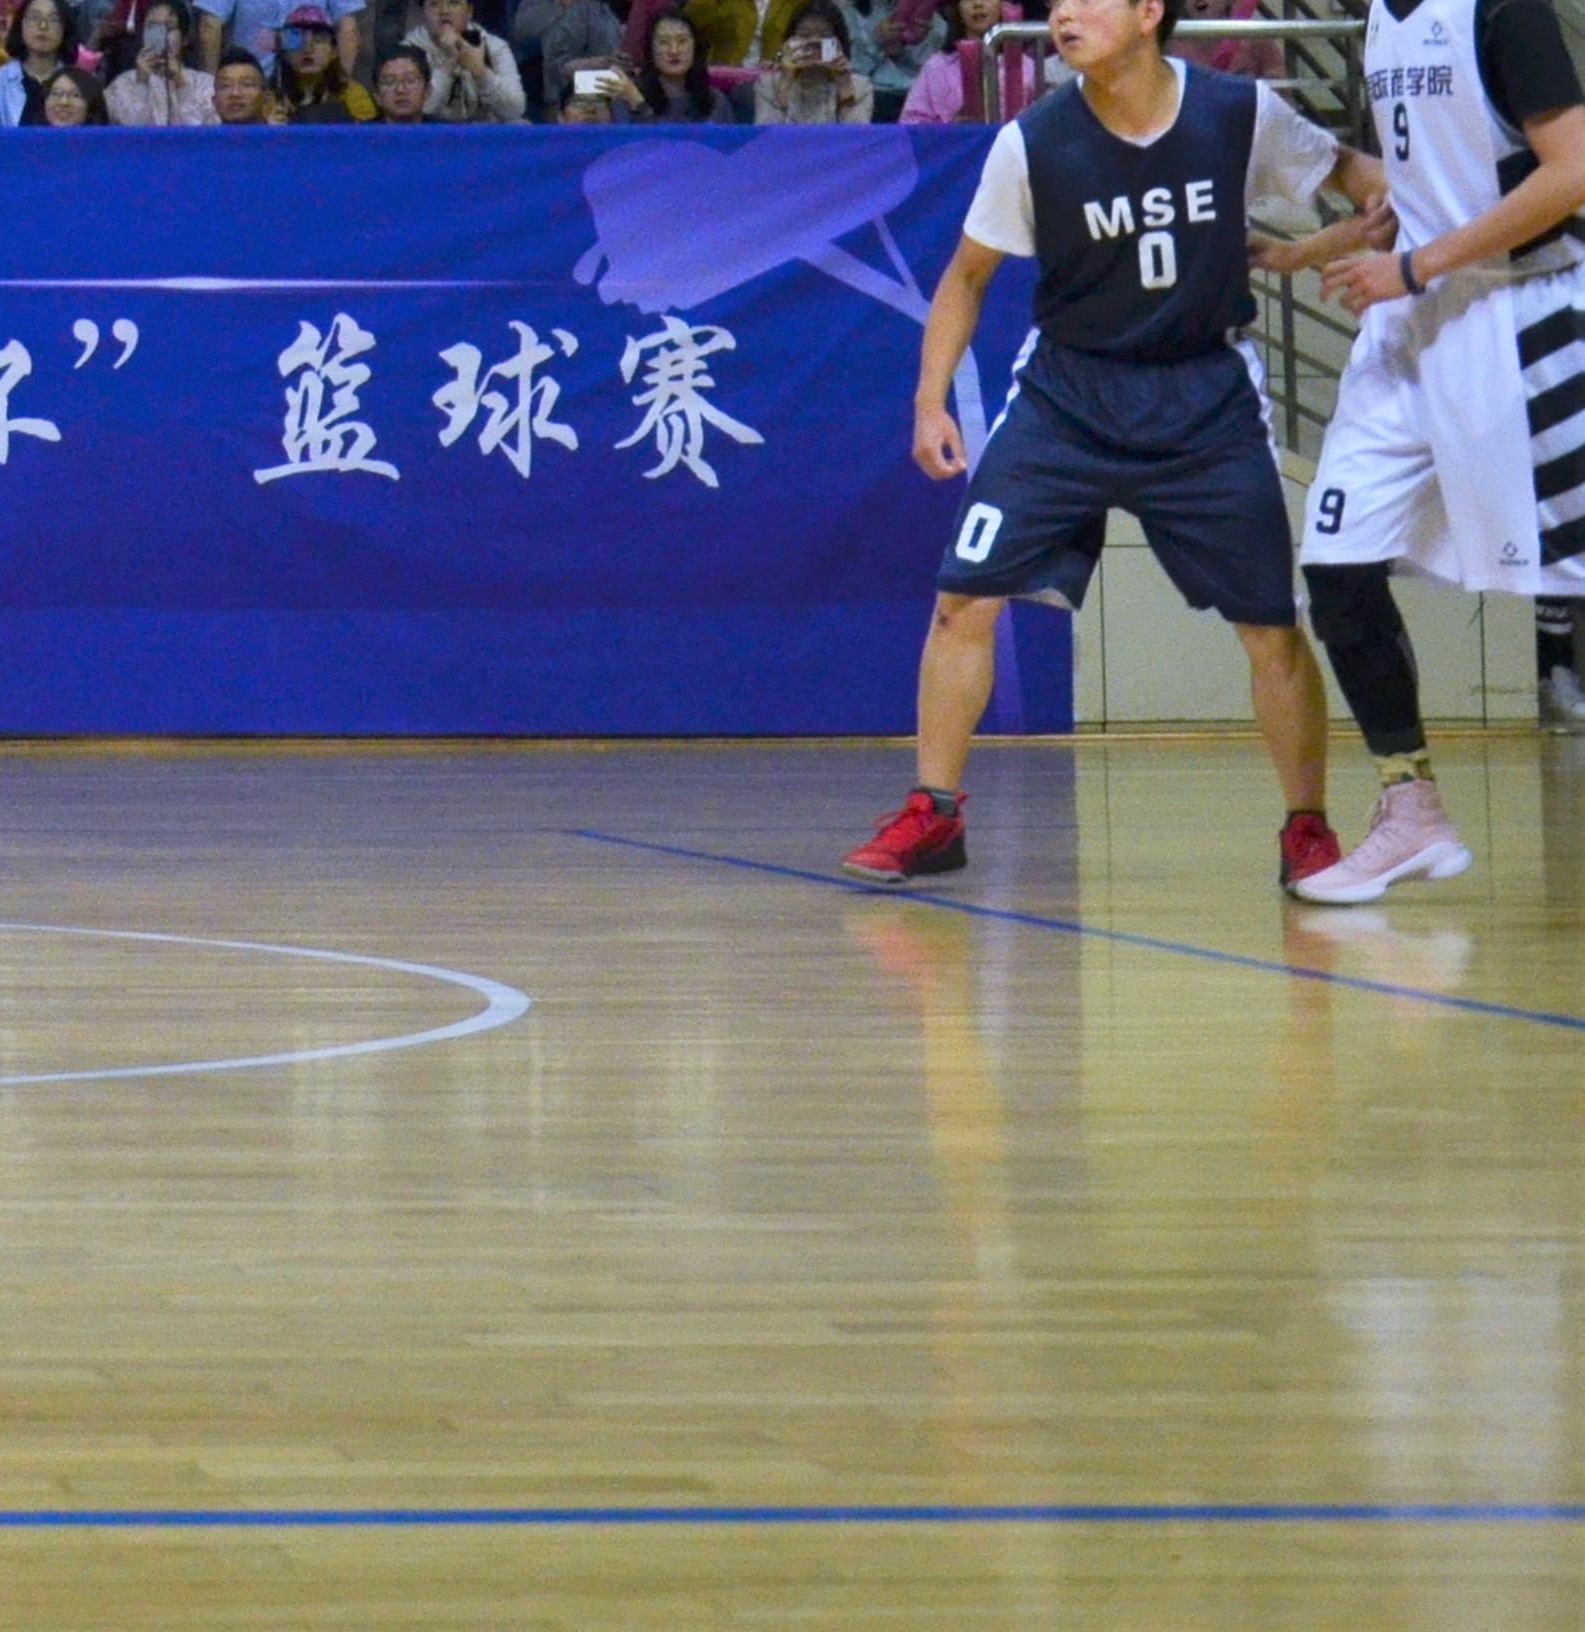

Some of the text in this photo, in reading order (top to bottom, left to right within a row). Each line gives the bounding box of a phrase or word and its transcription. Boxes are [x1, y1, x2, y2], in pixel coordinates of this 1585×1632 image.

[1367, 65, 1453, 100] 际商学院
[1394, 103, 1410, 161] 9
[1083, 180, 1216, 240] MSE
[1138, 231, 1177, 289] 0
[955, 502, 1003, 563] 0
[1316, 488, 1346, 535] 9
